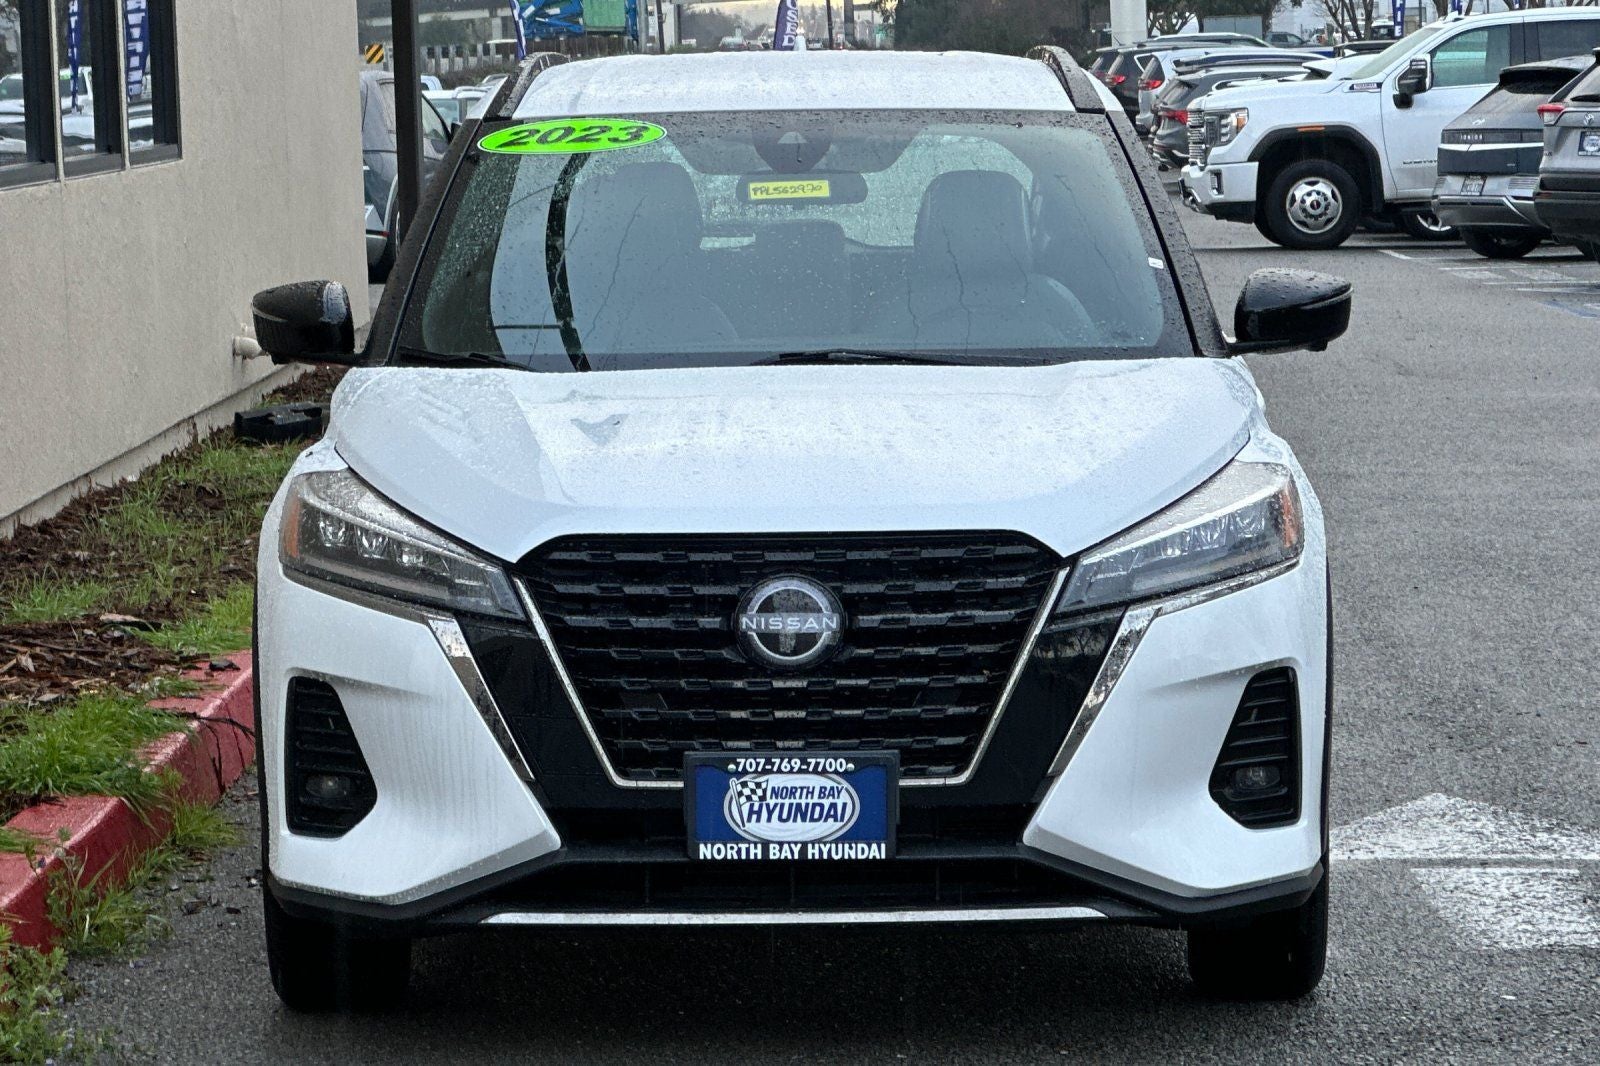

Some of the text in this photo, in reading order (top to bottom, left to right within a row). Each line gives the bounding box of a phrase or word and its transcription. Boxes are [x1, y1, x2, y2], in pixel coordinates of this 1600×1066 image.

[495, 124, 650, 148] 2023
[741, 616, 837, 630] NISSAN
[736, 758, 847, 773] 707-769-7700
[769, 786, 845, 800] NORTH BAY
[746, 802, 848, 823] HYUNDAI
[699, 843, 886, 860] NORTH BAY HYUNDAI
